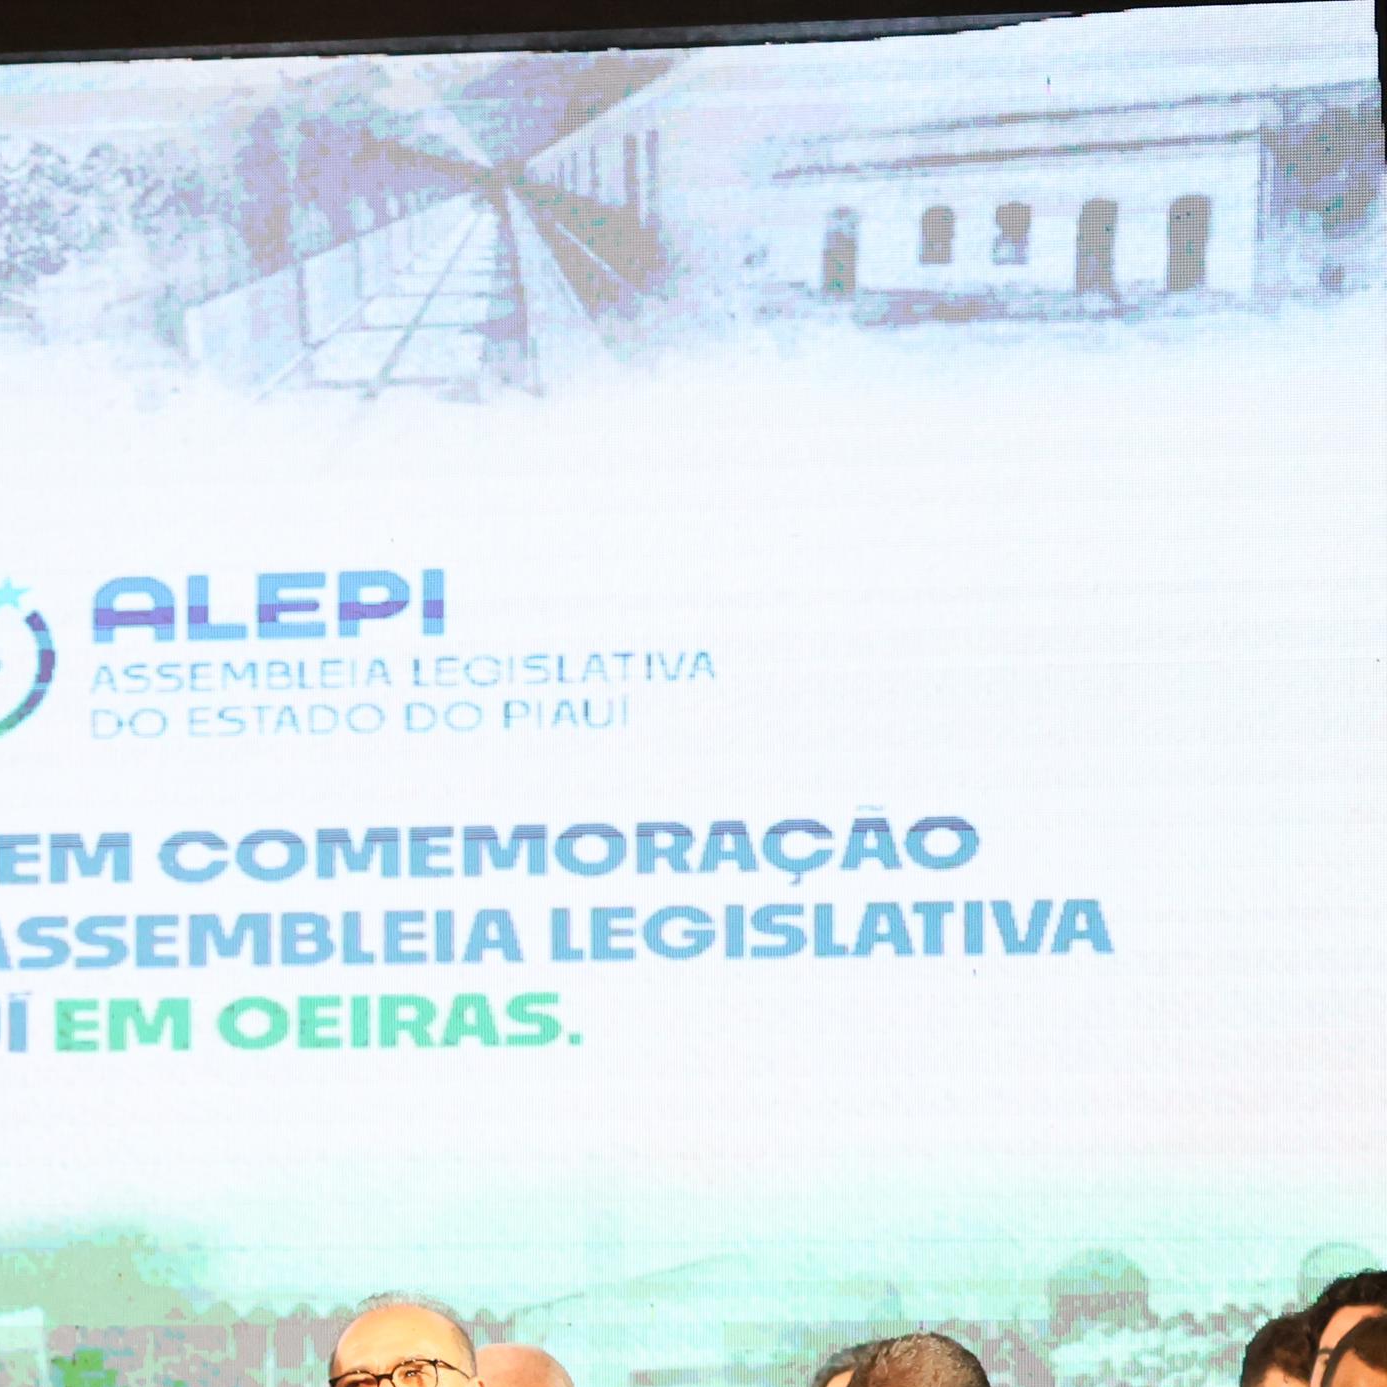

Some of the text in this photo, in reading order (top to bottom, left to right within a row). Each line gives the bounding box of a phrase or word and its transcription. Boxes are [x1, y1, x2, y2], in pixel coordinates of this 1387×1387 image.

[91, 568, 446, 644] ALEPI
[91, 650, 717, 694] ASSEMBLEIA LEGISLATIVA
[91, 706, 169, 740] DO
[187, 702, 385, 737] ESTADO
[403, 700, 484, 733] DO
[157, 806, 982, 887] COMEMORAÇÃO
[550, 898, 1115, 962] LEGISLATIVA
[54, 998, 193, 1053] EM
[215, 991, 584, 1052] OEIRAS.
